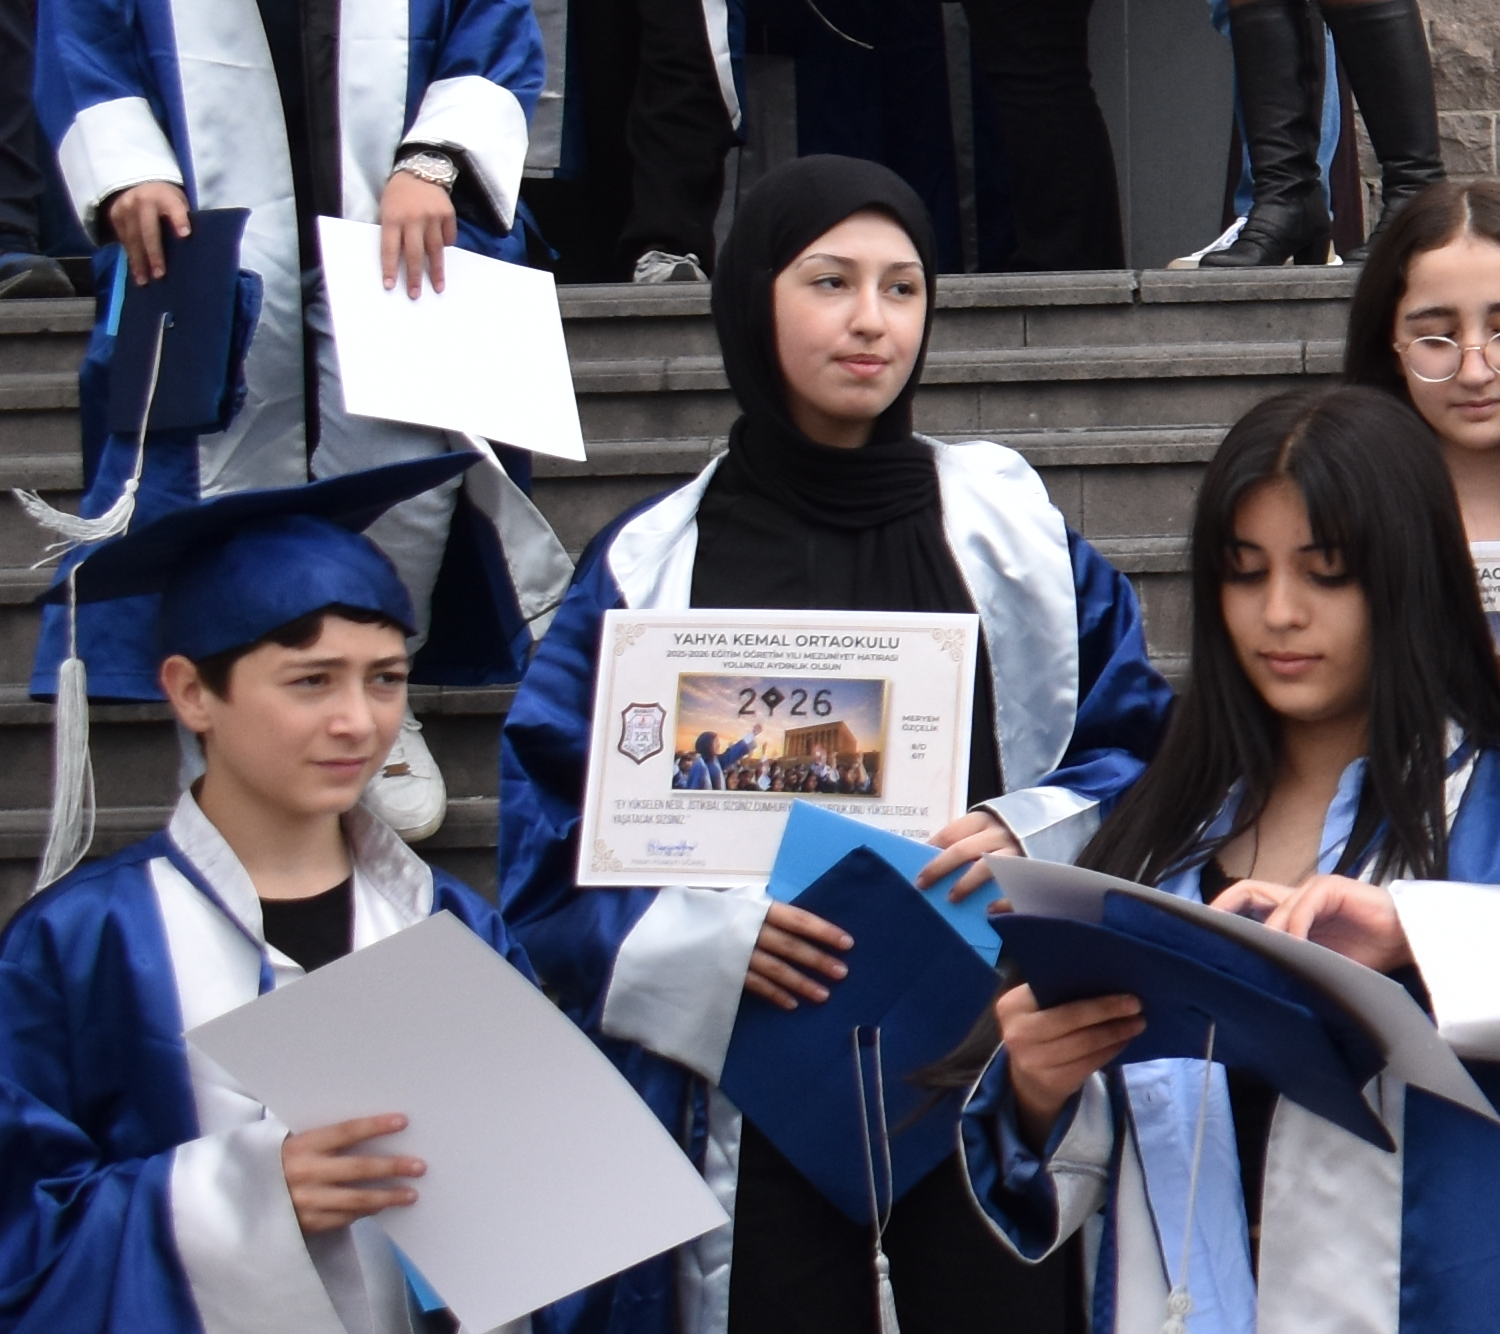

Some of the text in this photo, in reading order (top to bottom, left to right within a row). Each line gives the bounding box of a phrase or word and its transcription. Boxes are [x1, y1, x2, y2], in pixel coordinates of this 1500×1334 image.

[673, 633, 900, 650] YAHYA KEMAL ORTAOKULU
